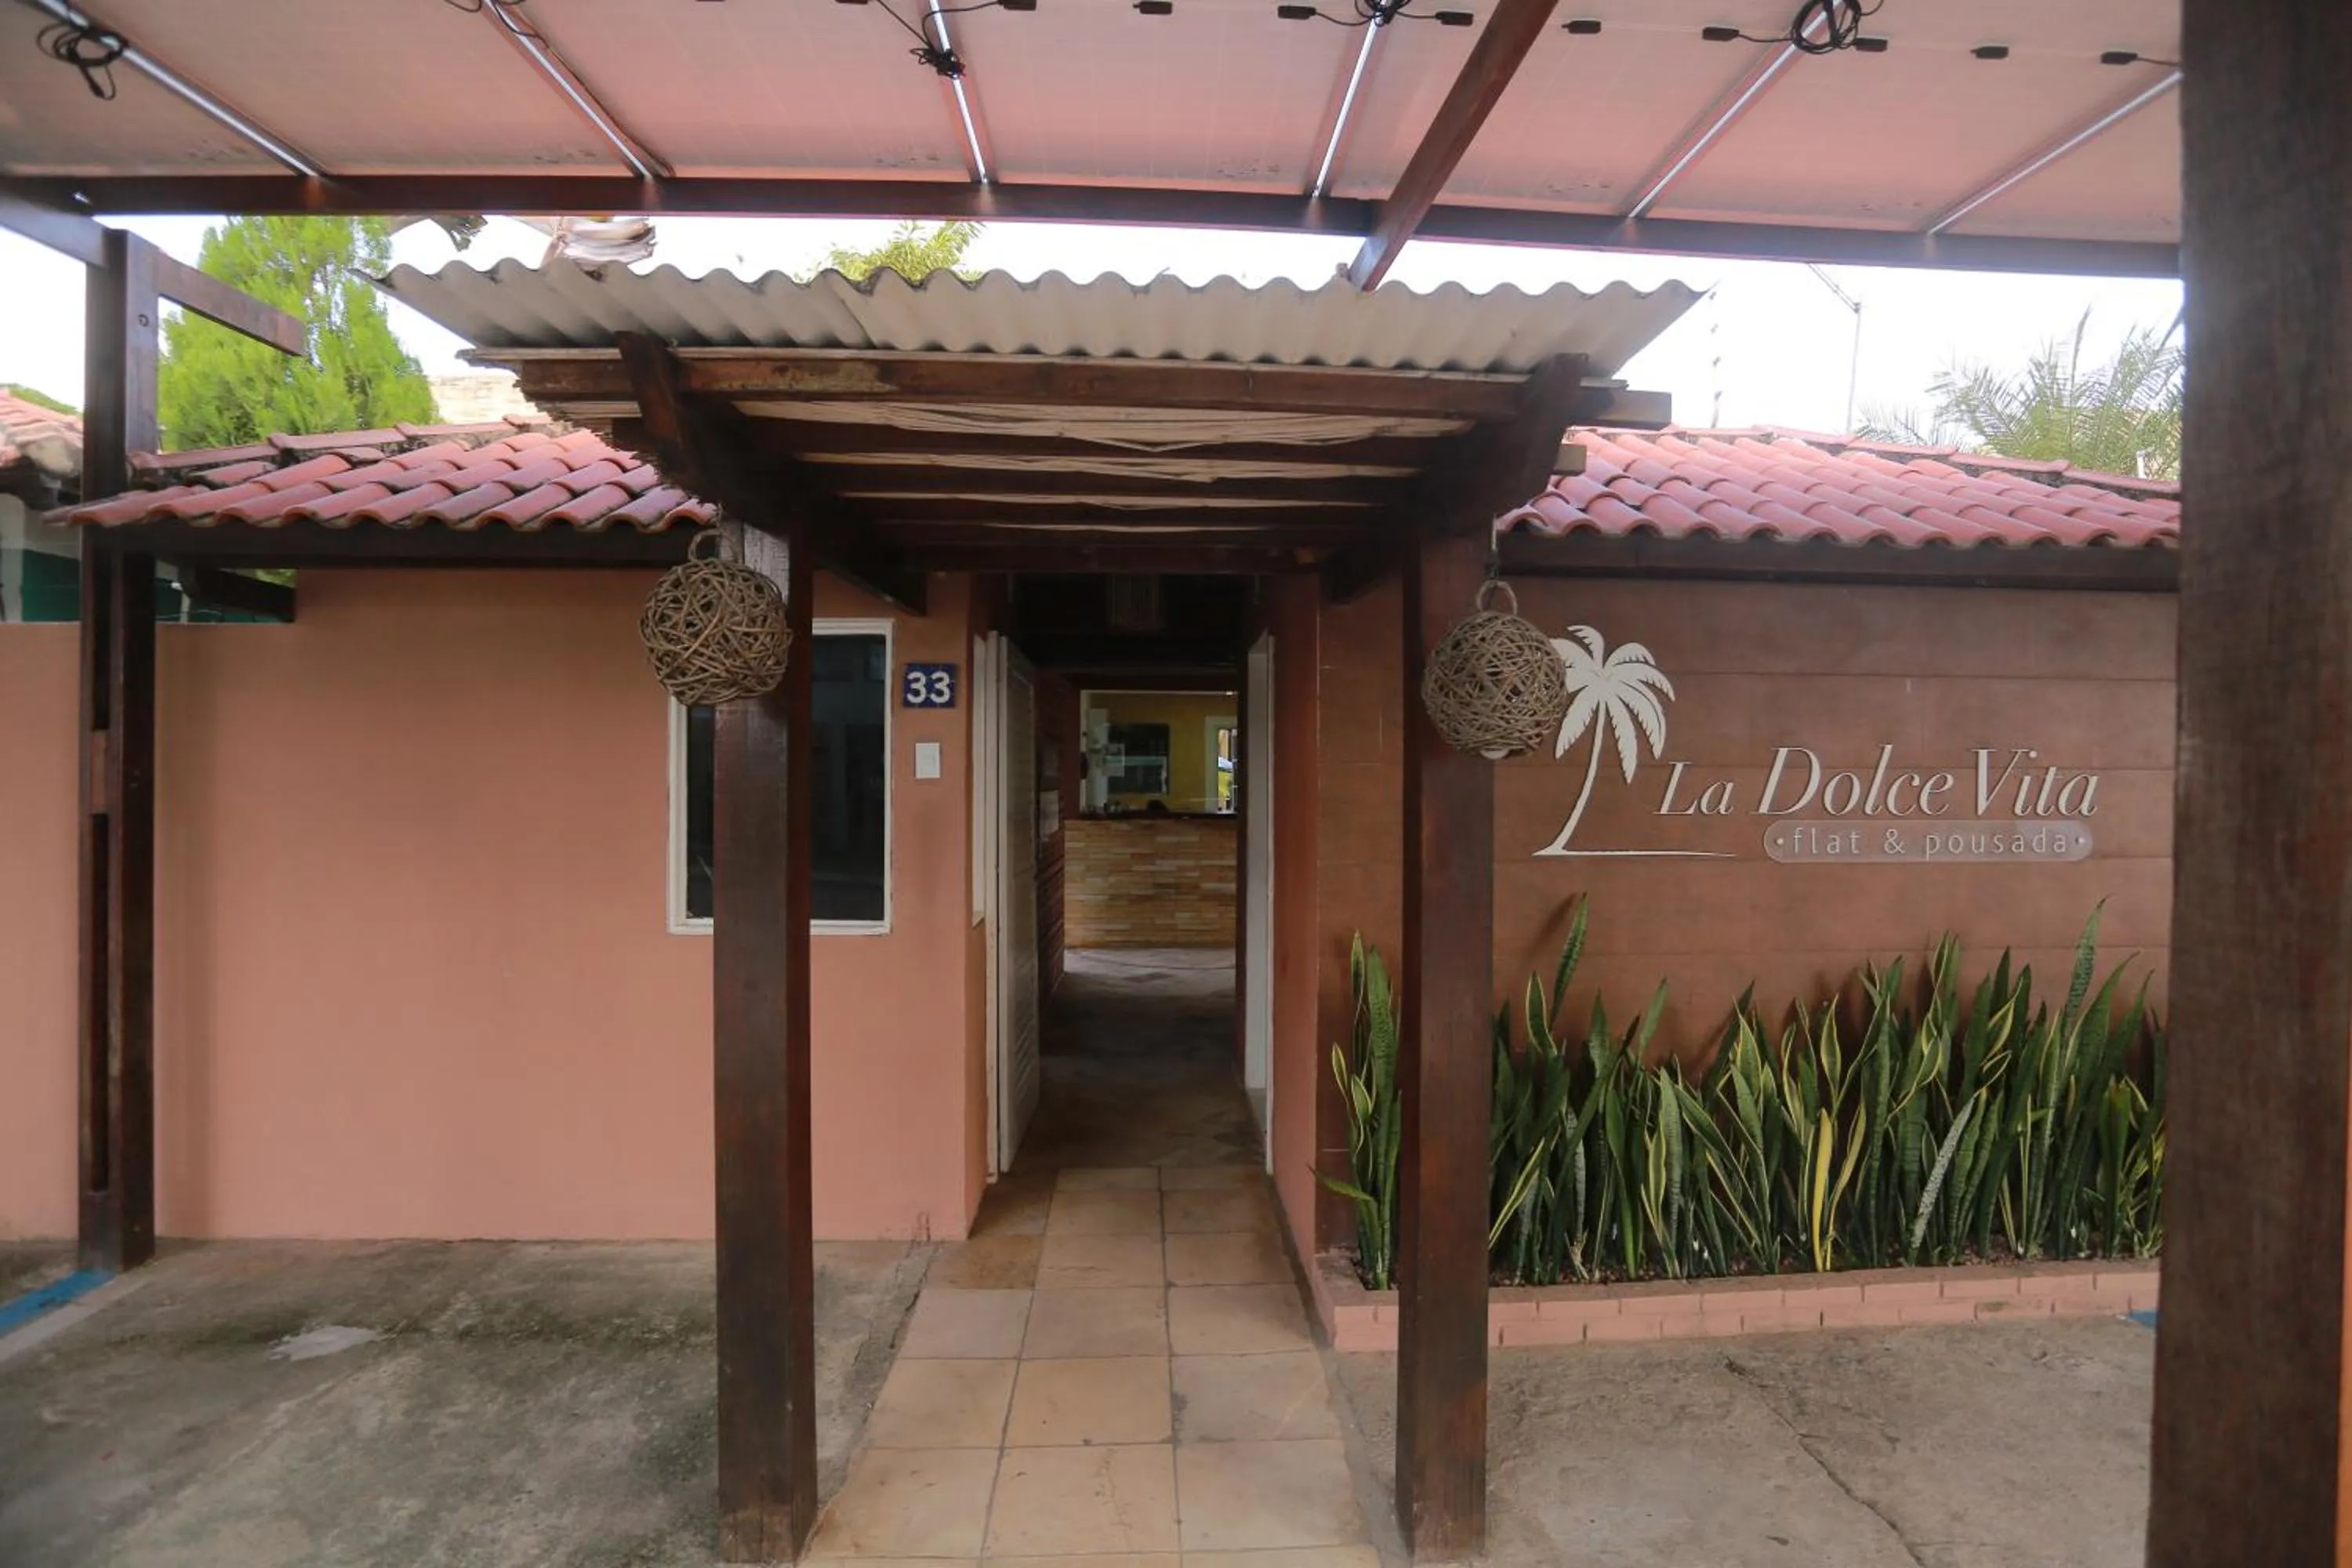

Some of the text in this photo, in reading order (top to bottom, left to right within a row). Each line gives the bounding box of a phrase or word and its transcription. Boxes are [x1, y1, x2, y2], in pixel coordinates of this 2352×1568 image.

[906, 671, 950, 703] 33
[1653, 744, 2100, 817] La Dolce Vita
[1792, 827, 2068, 861] flat & pousada
